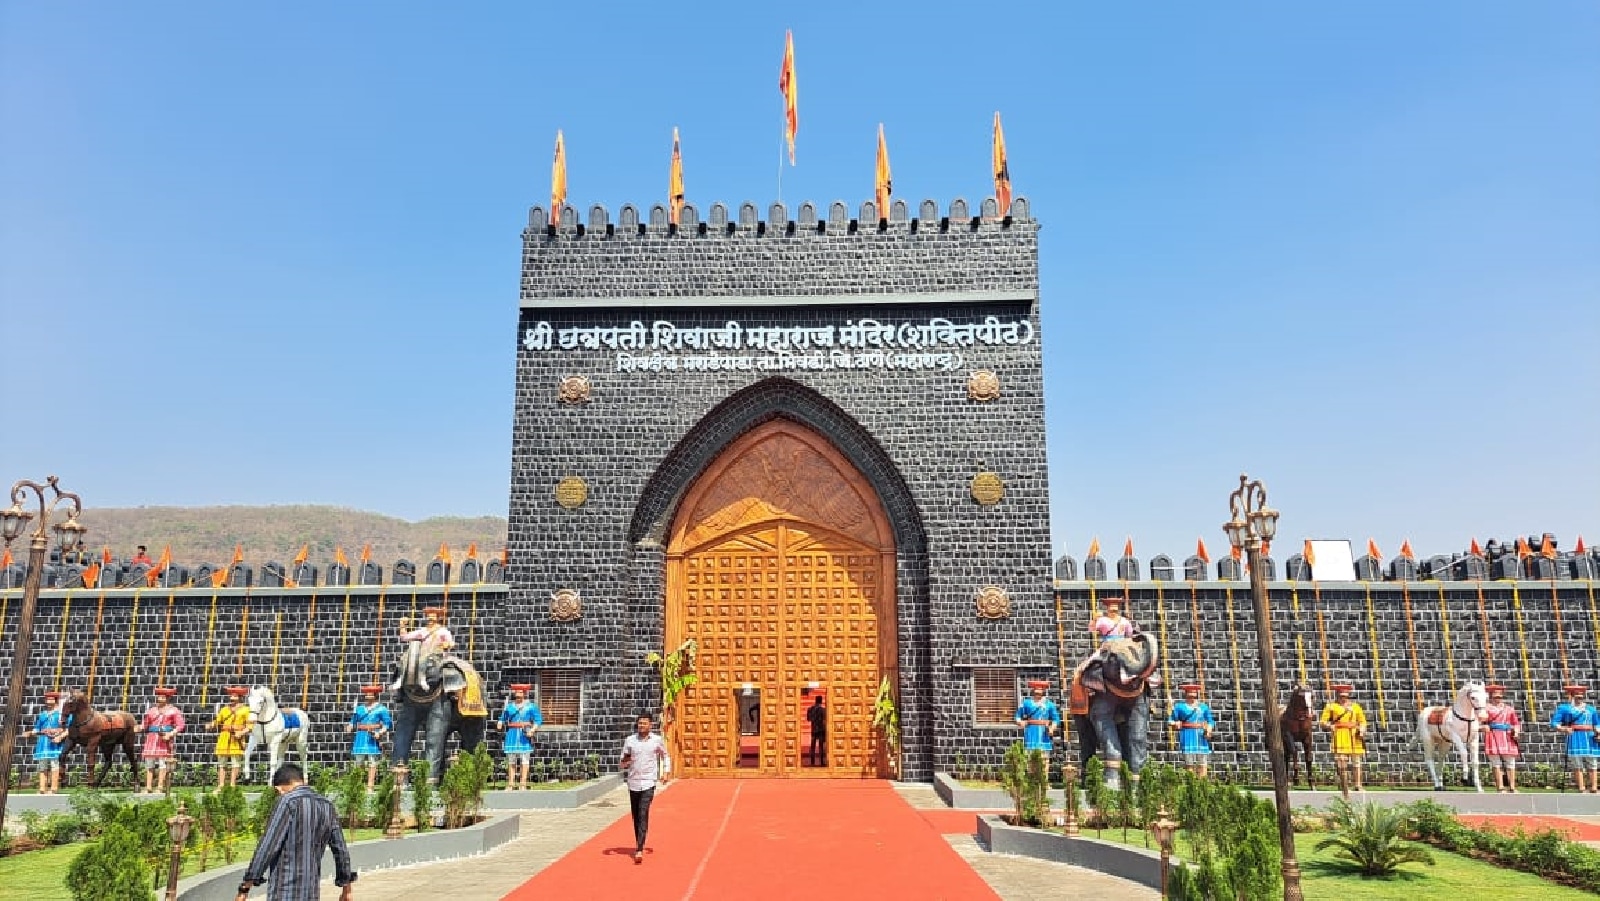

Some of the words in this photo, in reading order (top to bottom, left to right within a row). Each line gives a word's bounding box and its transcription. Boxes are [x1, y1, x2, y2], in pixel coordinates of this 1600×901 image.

[523, 321, 553, 350] श्री
[558, 321, 649, 350] छत्रपती
[652, 320, 743, 351] शिवाजी
[746, 325, 834, 352] महाराज
